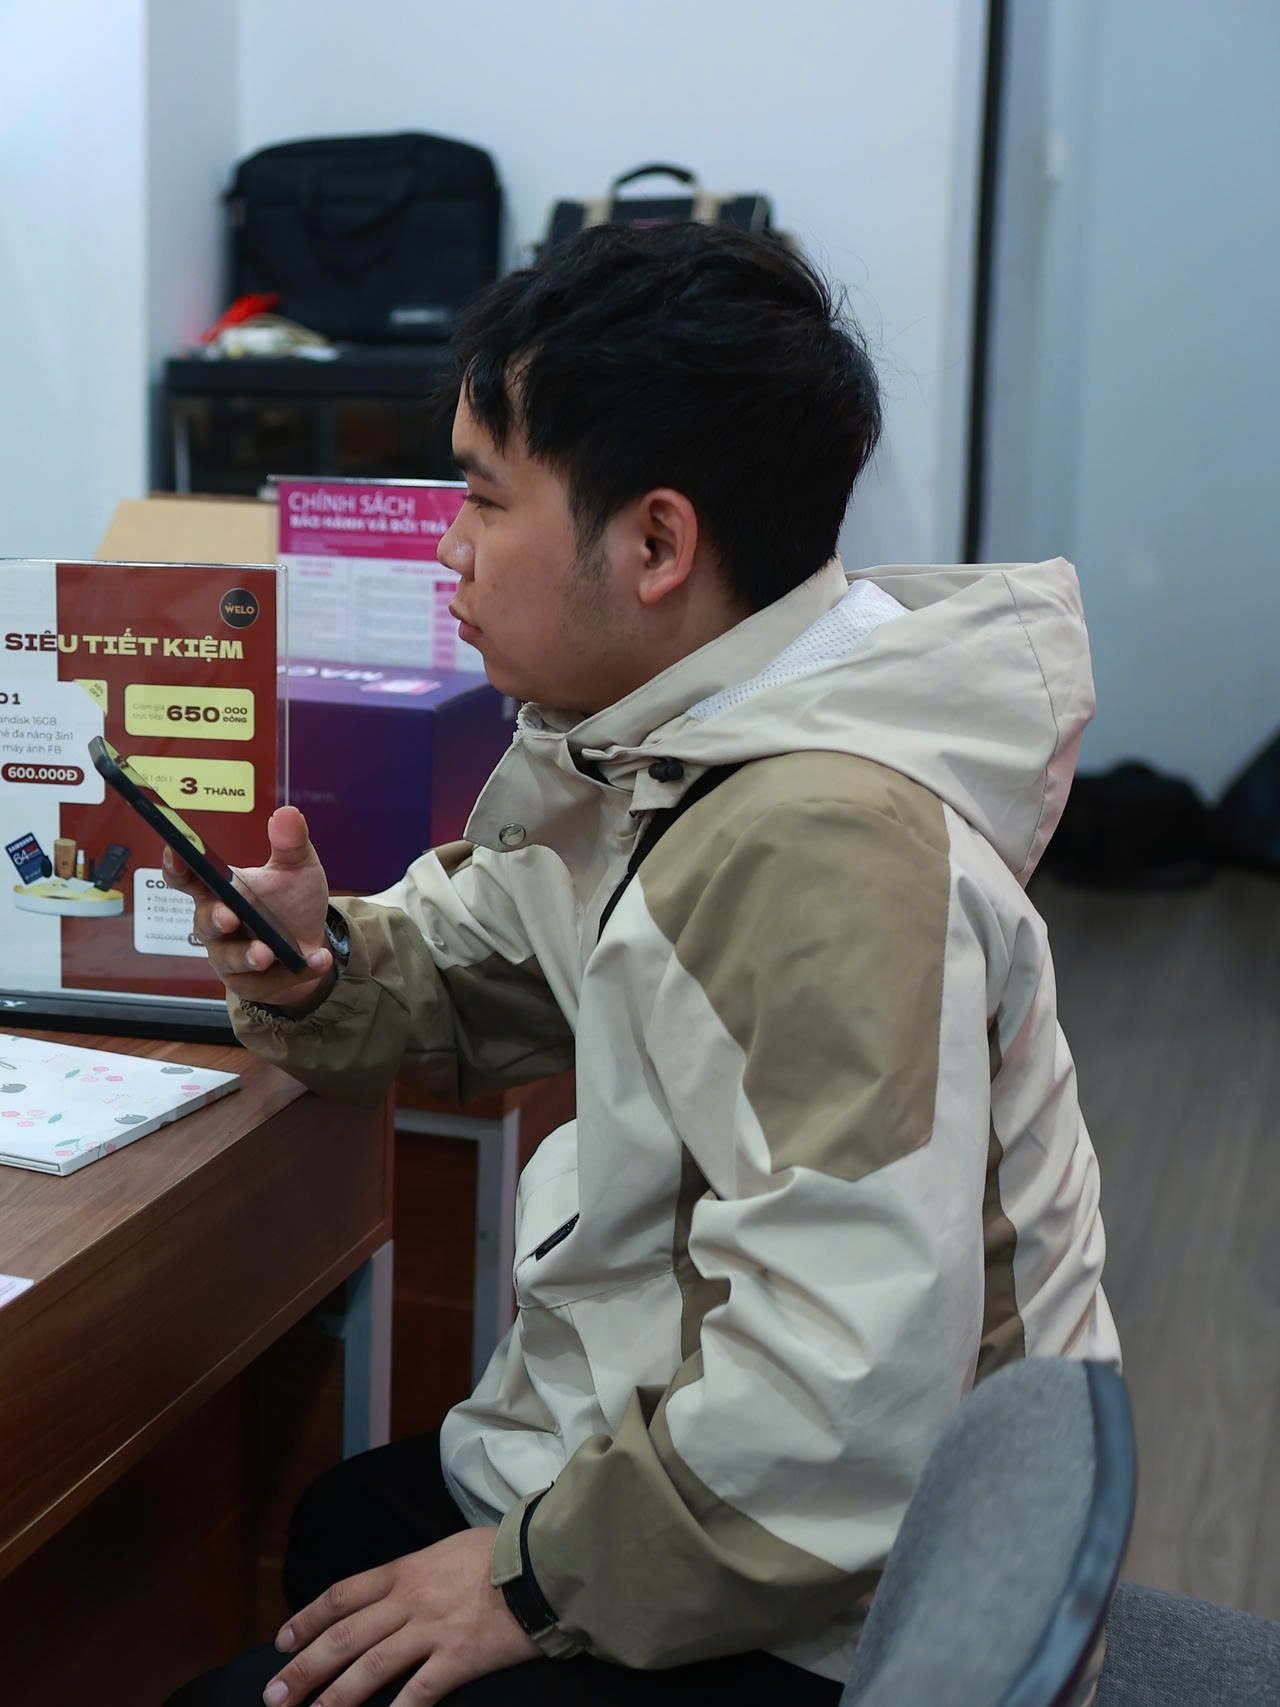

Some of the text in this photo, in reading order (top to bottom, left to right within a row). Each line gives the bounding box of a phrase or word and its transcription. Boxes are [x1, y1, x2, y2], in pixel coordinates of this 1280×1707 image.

[358, 491, 416, 516] SÁCH
[4, 630, 78, 653] SIÊU
[83, 627, 159, 656] TIẾT
[163, 635, 244, 662] KIỆM
[12, 693, 21, 705] 1
[32, 716, 57, 726] 16GB
[166, 704, 220, 723] 650
[7, 766, 78, 781] 600.000Đ
[180, 776, 246, 797] 3 THÁNG
[13, 849, 30, 865] 64
